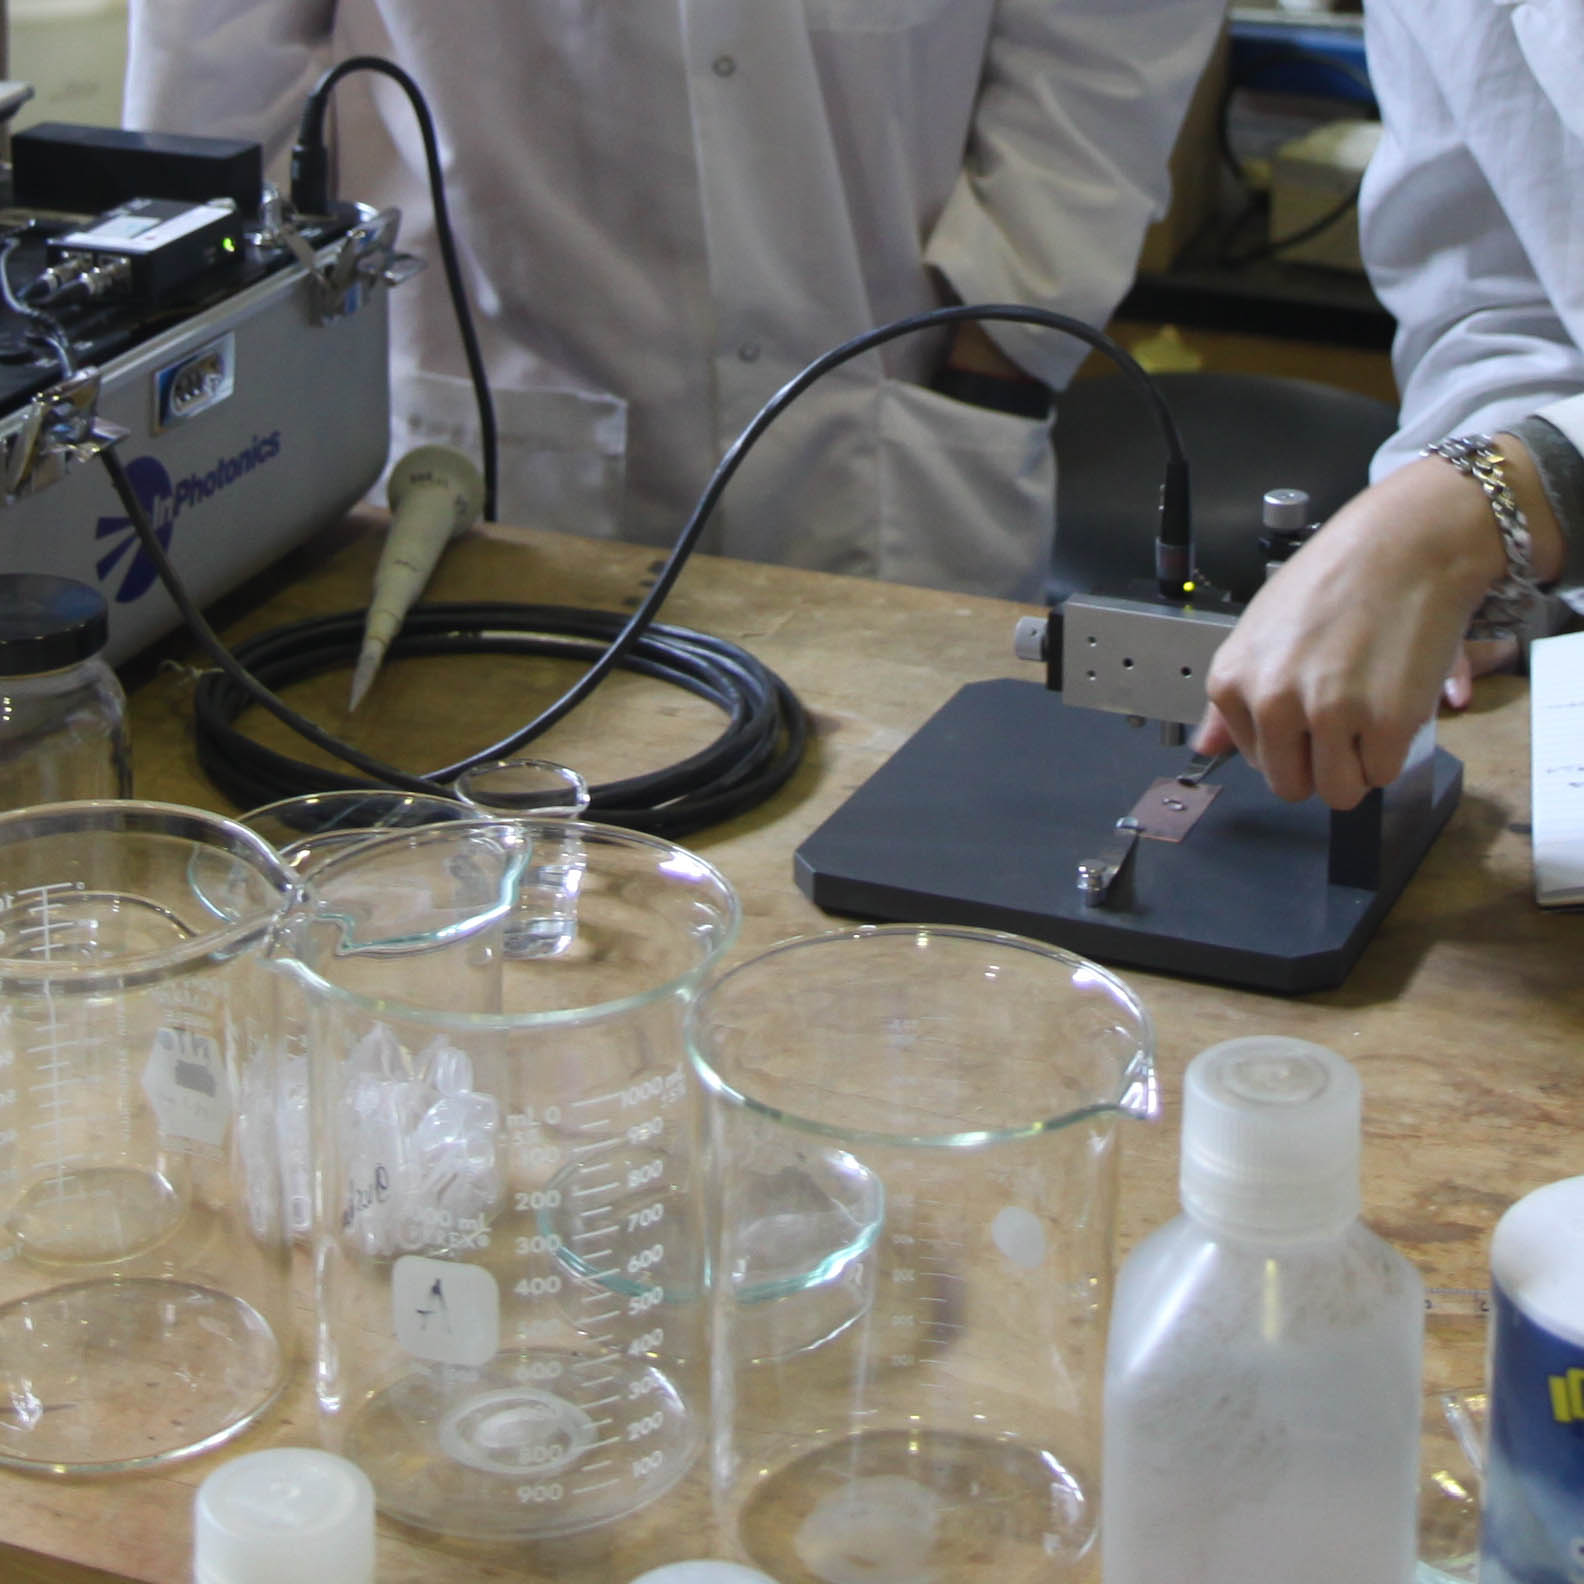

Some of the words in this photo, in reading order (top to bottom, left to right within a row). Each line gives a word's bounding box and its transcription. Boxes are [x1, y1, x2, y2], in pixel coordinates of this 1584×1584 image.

[620, 1075, 664, 1108] 1000
[544, 1105, 561, 1125] 0
[627, 1159, 664, 1189] 800
[514, 1190, 562, 1212] 200
[627, 1202, 664, 1233] 700
[514, 1235, 563, 1256] 300
[627, 1243, 664, 1274] 600
[514, 1275, 563, 1296] 400
[627, 1284, 664, 1317] 500
[626, 1410, 664, 1441] 200
[631, 1449, 664, 1478] 100
[516, 1482, 564, 1504] 900
